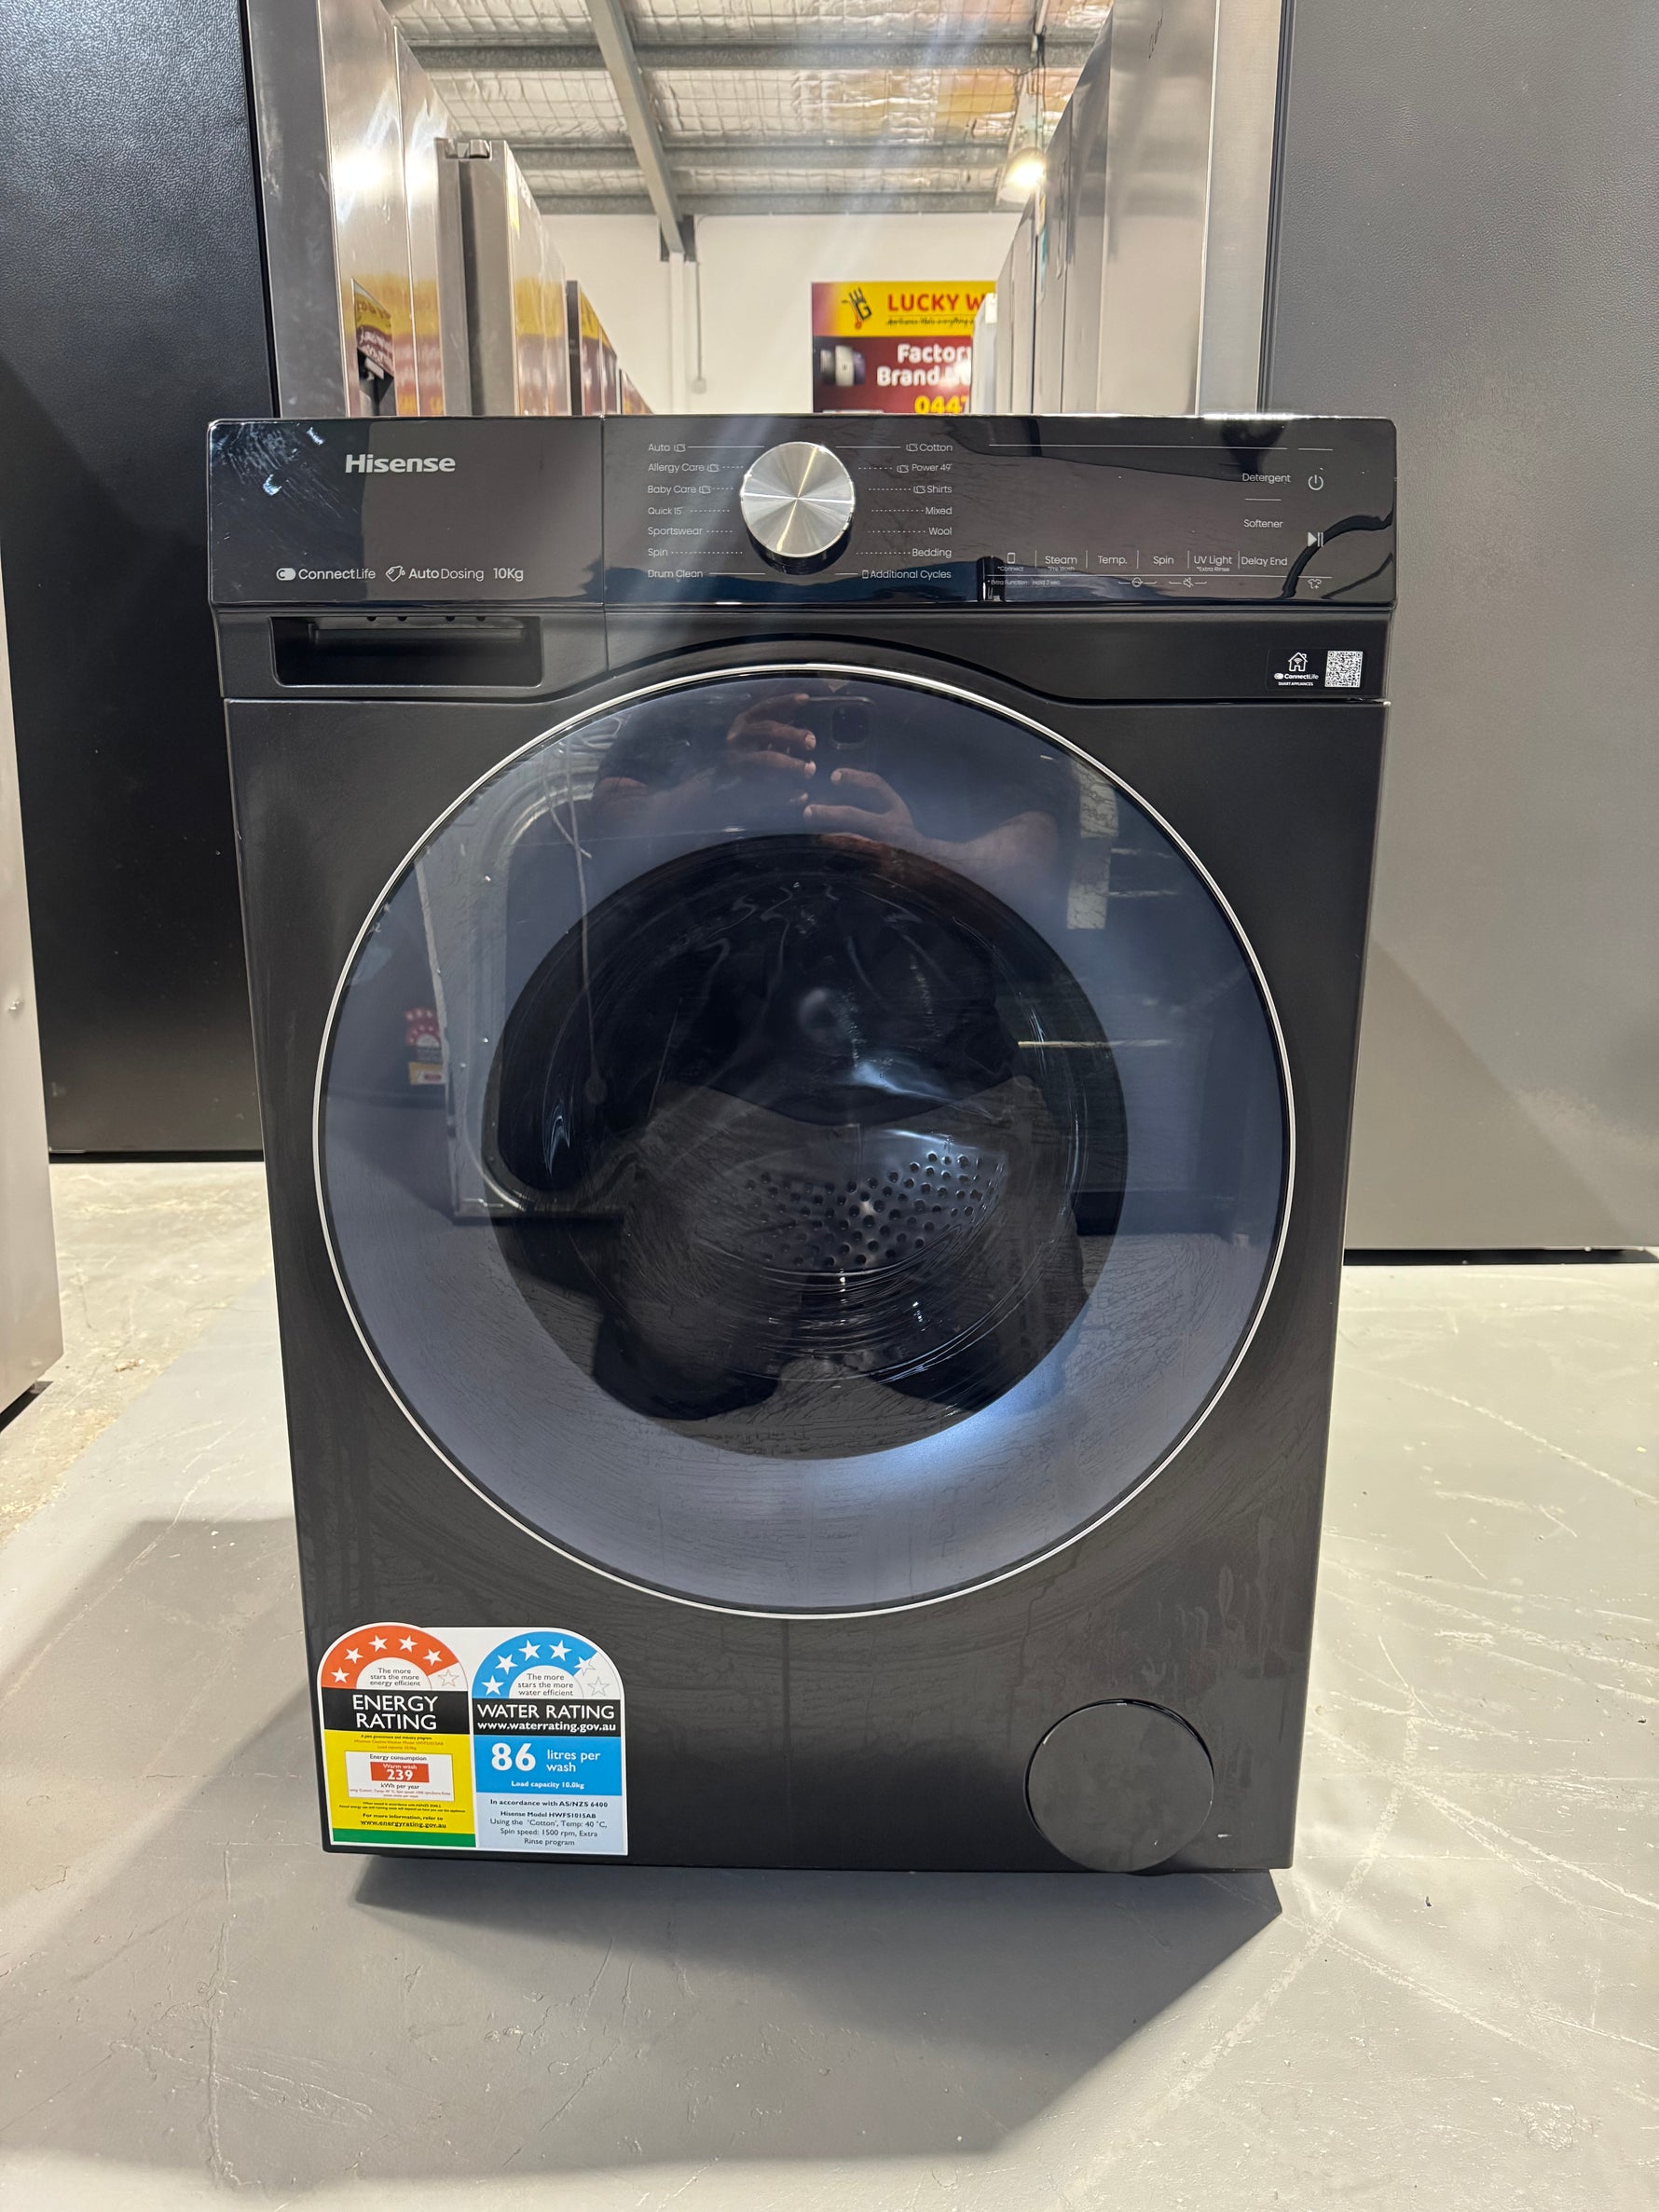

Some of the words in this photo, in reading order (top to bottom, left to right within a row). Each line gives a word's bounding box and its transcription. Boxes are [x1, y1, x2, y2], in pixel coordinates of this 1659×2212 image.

[888, 294, 959, 311] LUCKY
[876, 364, 940, 387] Brand
[648, 444, 670, 452] Auto
[919, 443, 953, 452] Cotton
[345, 454, 456, 474] Hisense
[648, 463, 679, 474] Allergy
[681, 463, 705, 472] Care
[912, 463, 939, 473] Power
[1241, 473, 1291, 486] Detergent
[648, 485, 671, 496] Baby
[673, 485, 697, 493] Care
[926, 485, 953, 494] Shirts
[648, 506, 673, 515] Quick
[925, 506, 953, 515] Mixed
[1243, 518, 1283, 529] Softener
[648, 527, 703, 537] Sportswear
[928, 527, 953, 536] Wool
[648, 548, 668, 558] Spin
[912, 548, 953, 558] Bedding
[1045, 556, 1077, 565] Steam
[1098, 556, 1127, 566] Temp.
[1153, 556, 1174, 566] Spin
[1194, 556, 1207, 564] UV
[1209, 556, 1233, 566] Light
[1241, 556, 1268, 567] Delay
[1270, 557, 1287, 566] End
[493, 568, 524, 582] 10Kg
[648, 570, 675, 579] Drum
[676, 570, 703, 579] Clean
[870, 570, 918, 579] Additional
[920, 570, 952, 580] Cycles
[352, 1695, 439, 1712] ENERGY
[477, 1704, 540, 1718] WATER
[546, 1705, 614, 1719] RATING
[356, 1712, 437, 1730] RATING
[477, 1722, 616, 1733] www.waterrating.gov.au
[491, 1742, 536, 1772] 86
[547, 1750, 576, 1760] litres
[581, 1752, 601, 1763] per
[546, 1762, 576, 1772] wash
[387, 1769, 413, 1780] 239
[360, 1820, 446, 1829] www.energyrating.gov.au
